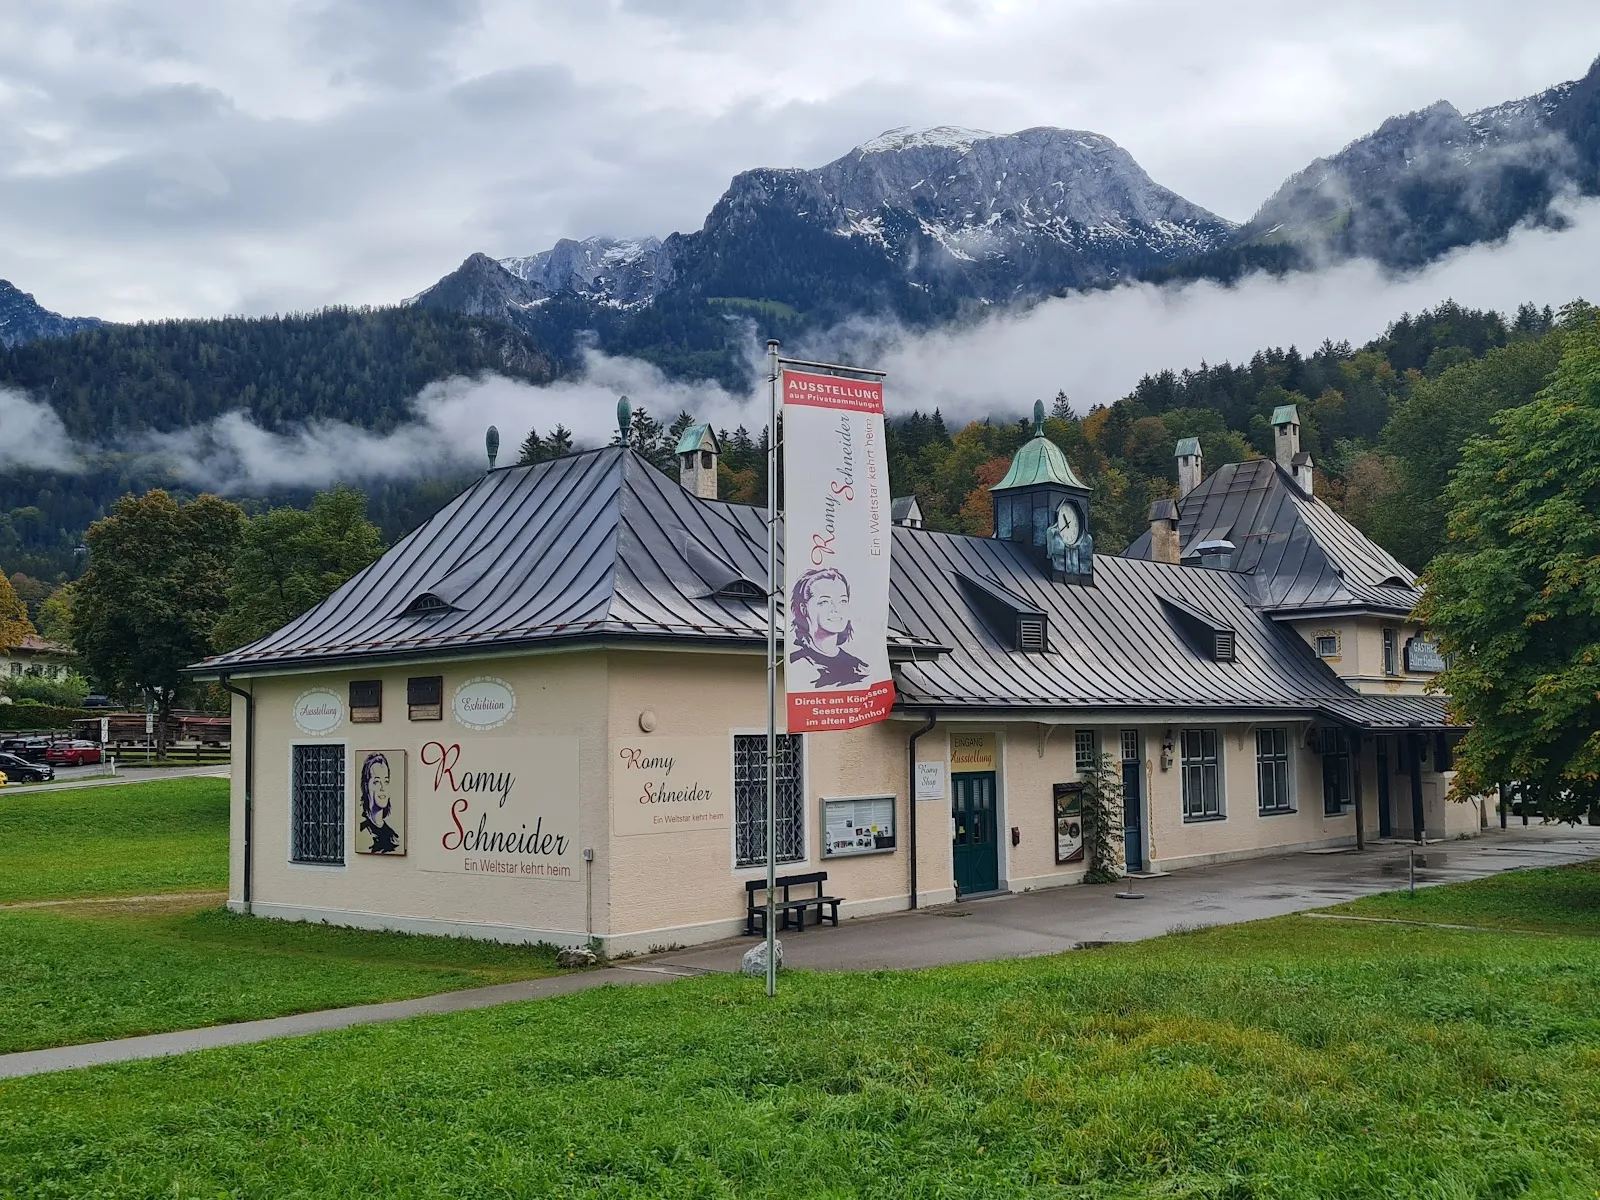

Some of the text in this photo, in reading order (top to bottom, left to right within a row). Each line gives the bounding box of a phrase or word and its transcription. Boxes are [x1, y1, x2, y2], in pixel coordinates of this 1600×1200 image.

[789, 380, 879, 400] AUSSTELLUNG
[811, 413, 854, 565] Romy Schneider
[864, 419, 881, 556] Ein Weltstar kehrt heim
[461, 697, 505, 713] Exhibition
[795, 697, 826, 706] Direkt
[847, 687, 888, 704] Könssee
[299, 703, 337, 719] Ausstellung
[812, 701, 874, 715] Seestrass 17
[821, 717, 845, 725] alten
[954, 737, 983, 747] EINGANG
[619, 747, 676, 776] Romy
[951, 750, 992, 767] Ausstellung
[420, 741, 516, 808] Romy
[917, 763, 938, 777] Romy
[921, 776, 936, 788] Shop
[639, 781, 713, 804] Schneider
[653, 811, 724, 824] Ein Weltstar kehrt heim
[442, 798, 570, 856] Schneider
[464, 857, 571, 877] Ein Weltstar kehrt heim
